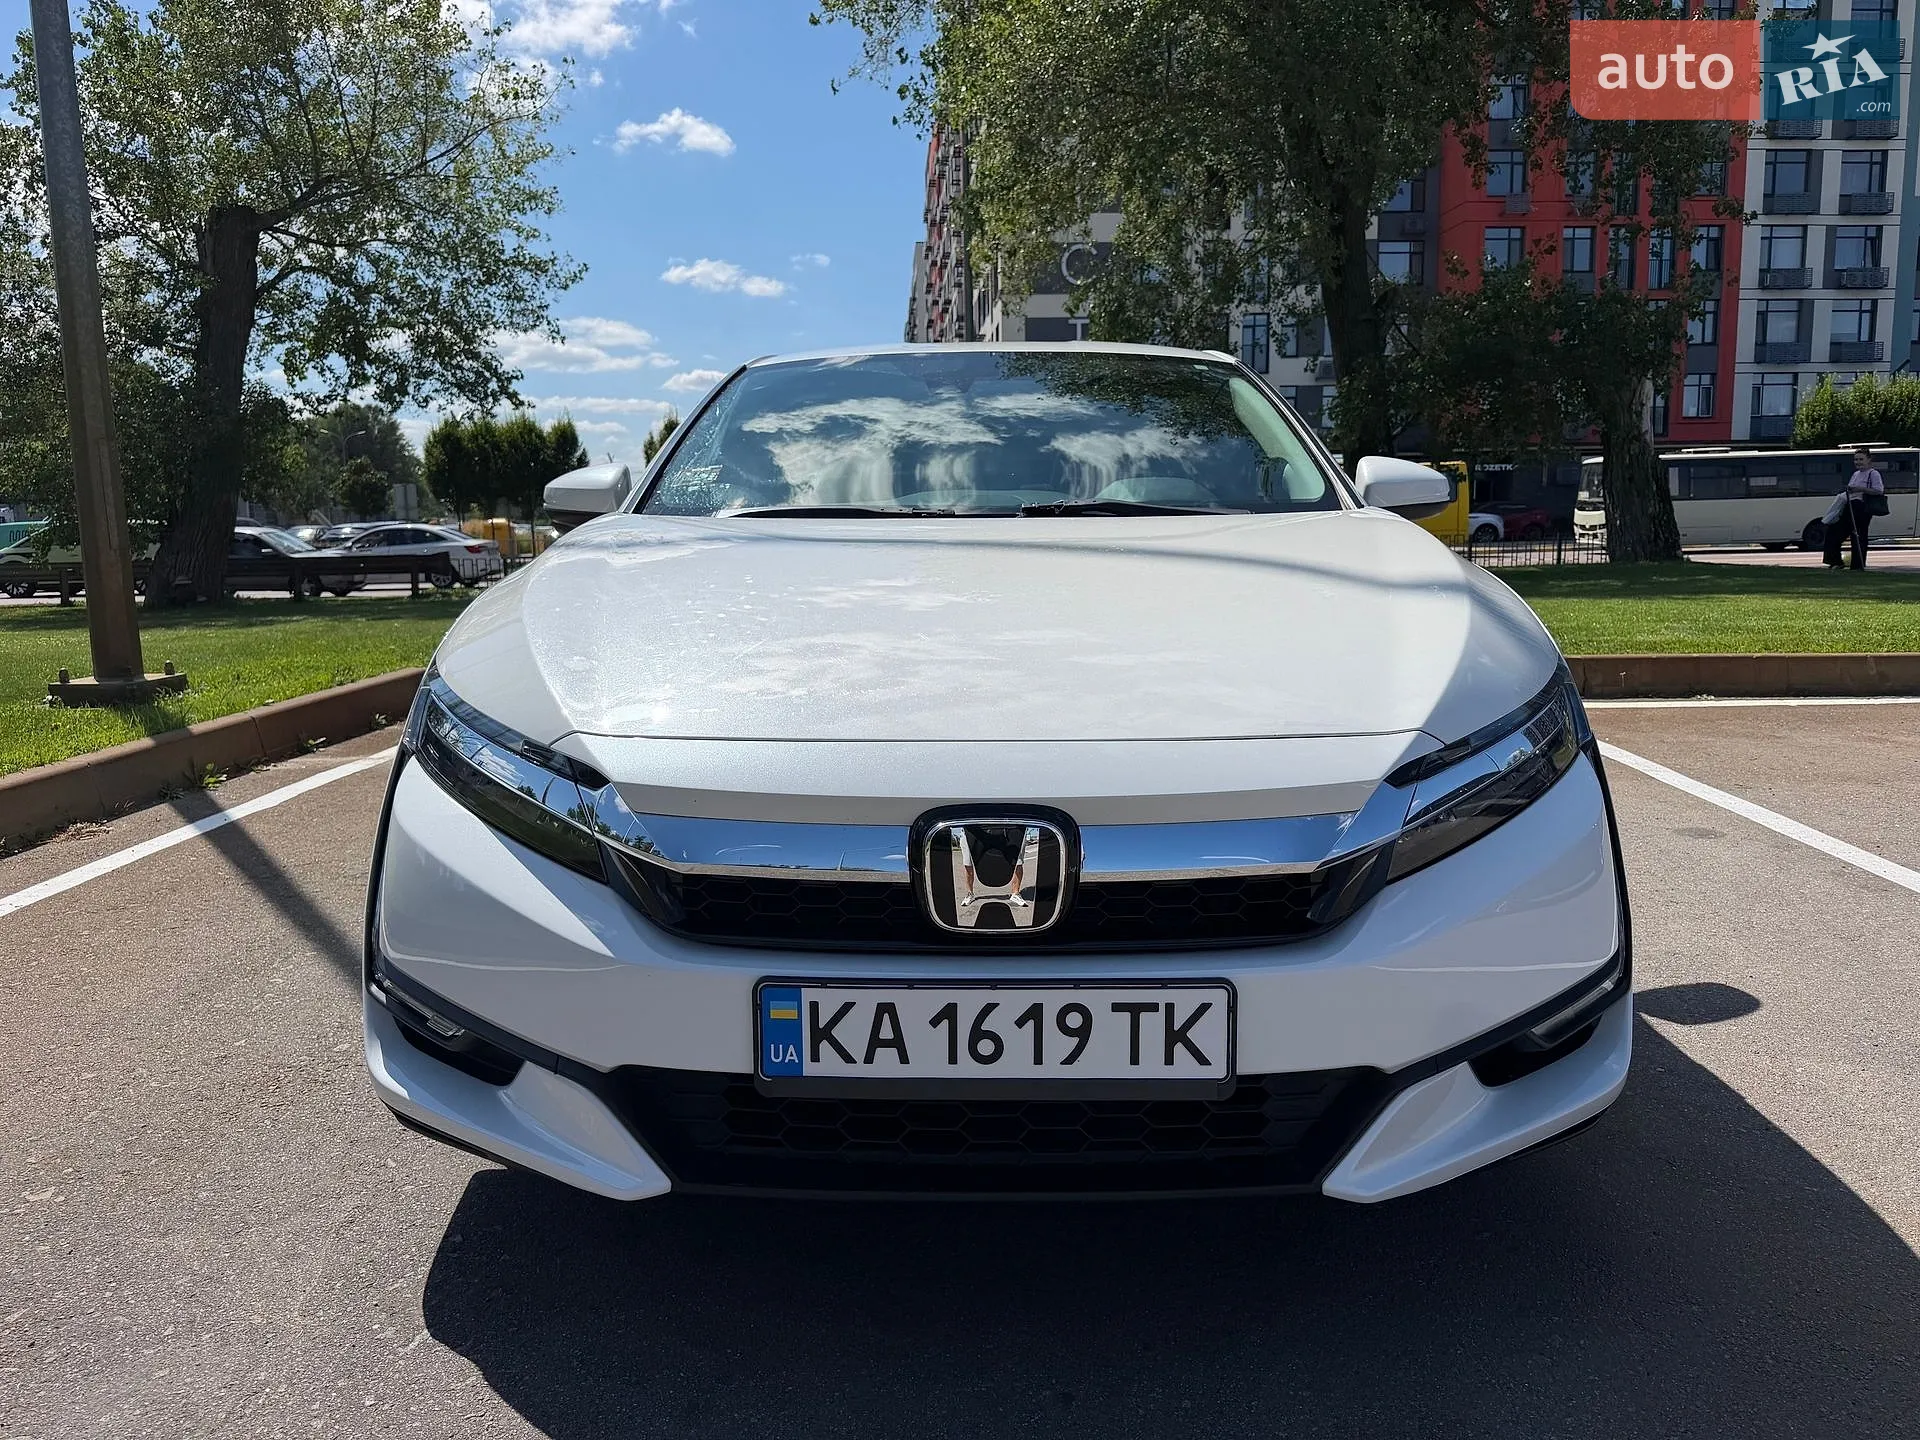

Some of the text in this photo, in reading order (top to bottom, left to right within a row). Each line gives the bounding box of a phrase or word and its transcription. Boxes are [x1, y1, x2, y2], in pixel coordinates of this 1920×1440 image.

[770, 1044, 799, 1063] UA
[809, 1001, 1213, 1066] KA 1619 TK
